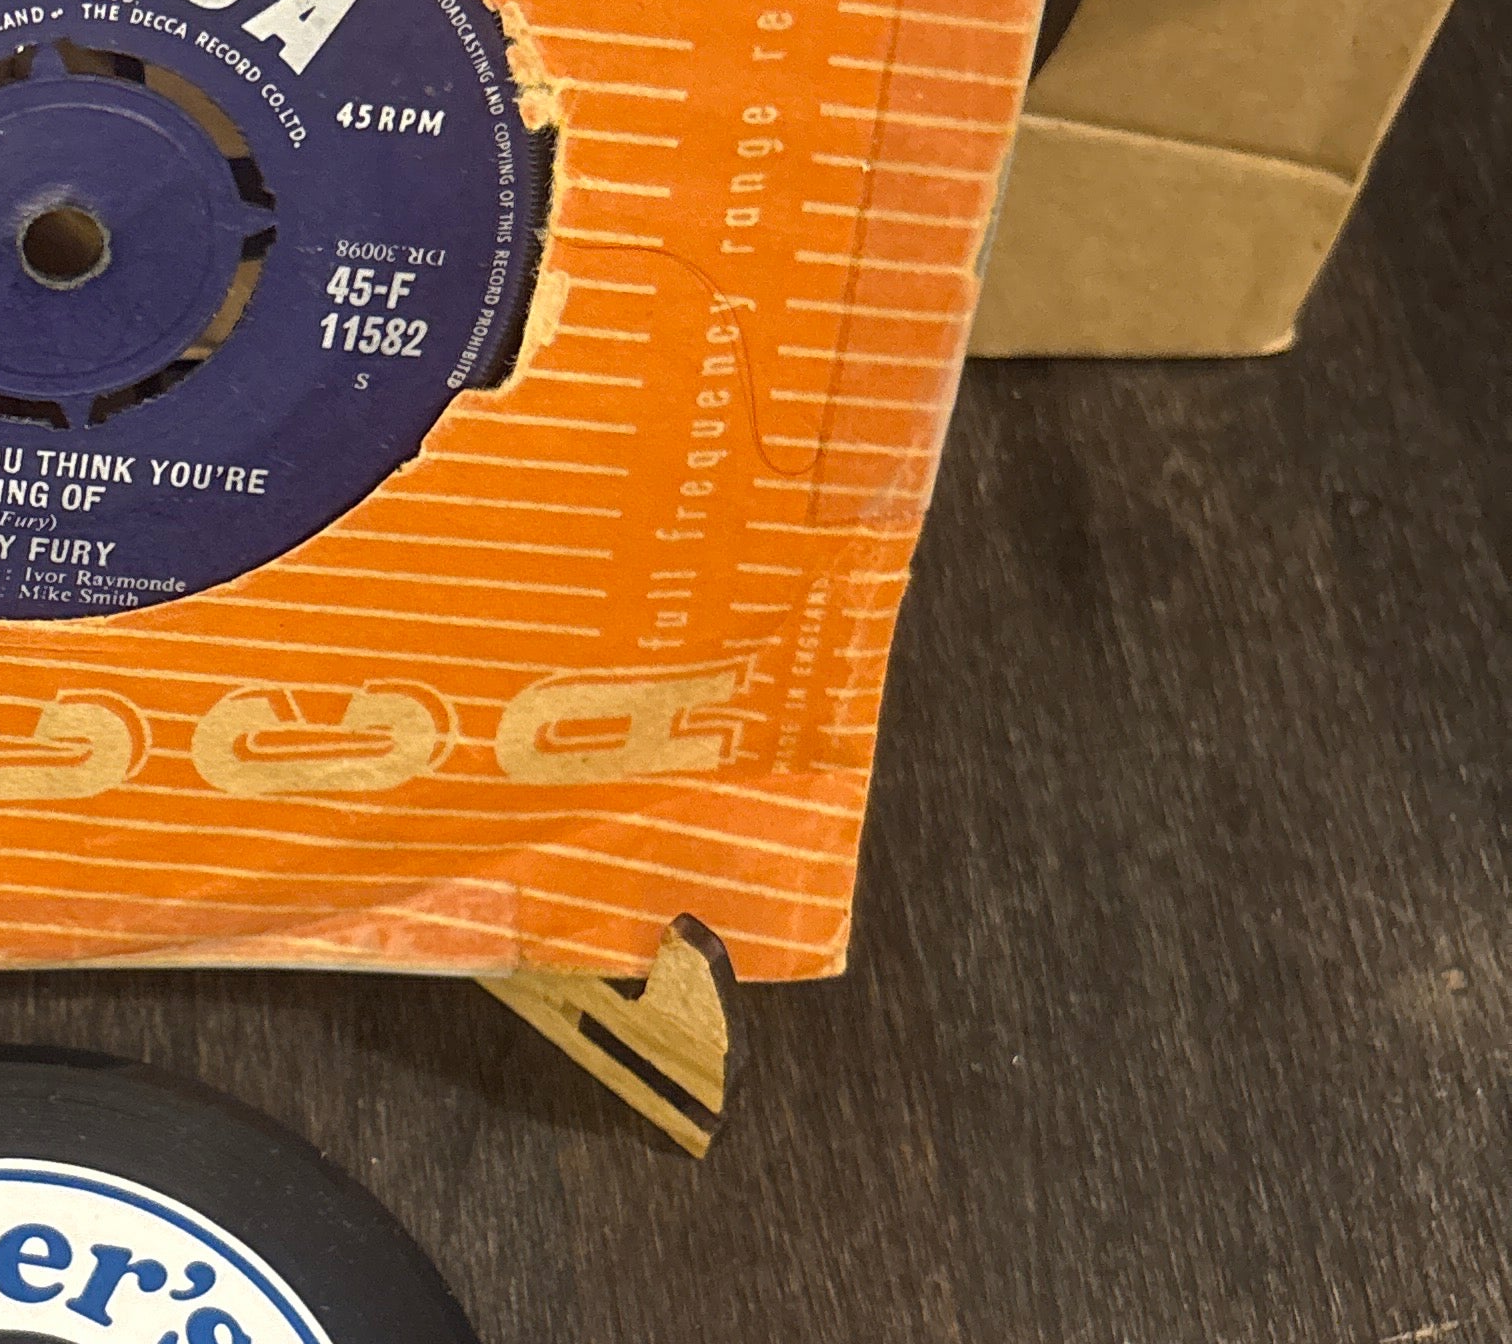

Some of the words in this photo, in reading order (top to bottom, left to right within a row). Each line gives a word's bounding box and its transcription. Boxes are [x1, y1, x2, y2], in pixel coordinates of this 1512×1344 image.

[81, 3, 120, 22] THE
[130, 8, 188, 40] DECCA
[194, 31, 262, 83] RECORD
[484, 85, 505, 116] AND
[494, 122, 515, 186] COPYING
[499, 190, 514, 209] OF
[497, 212, 514, 244] THIS
[326, 266, 417, 310] 45-F
[484, 249, 510, 306] RECORD
[320, 312, 429, 358] 11582
[655, 292, 756, 542] frequency
[720, 104, 784, 255] range
[446, 308, 495, 389] PROHIBITED
[36, 450, 137, 485] THINK
[150, 459, 270, 495] YOU'RE
[61, 484, 107, 512] OF
[28, 536, 117, 568] FURY
[18, 584, 72, 603] Mike
[77, 588, 139, 607] Smith
[25, 566, 67, 584] Ivor
[76, 569, 187, 594] Raymonde
[791, 577, 830, 676] ENGLAND
[785, 688, 808, 709] IN
